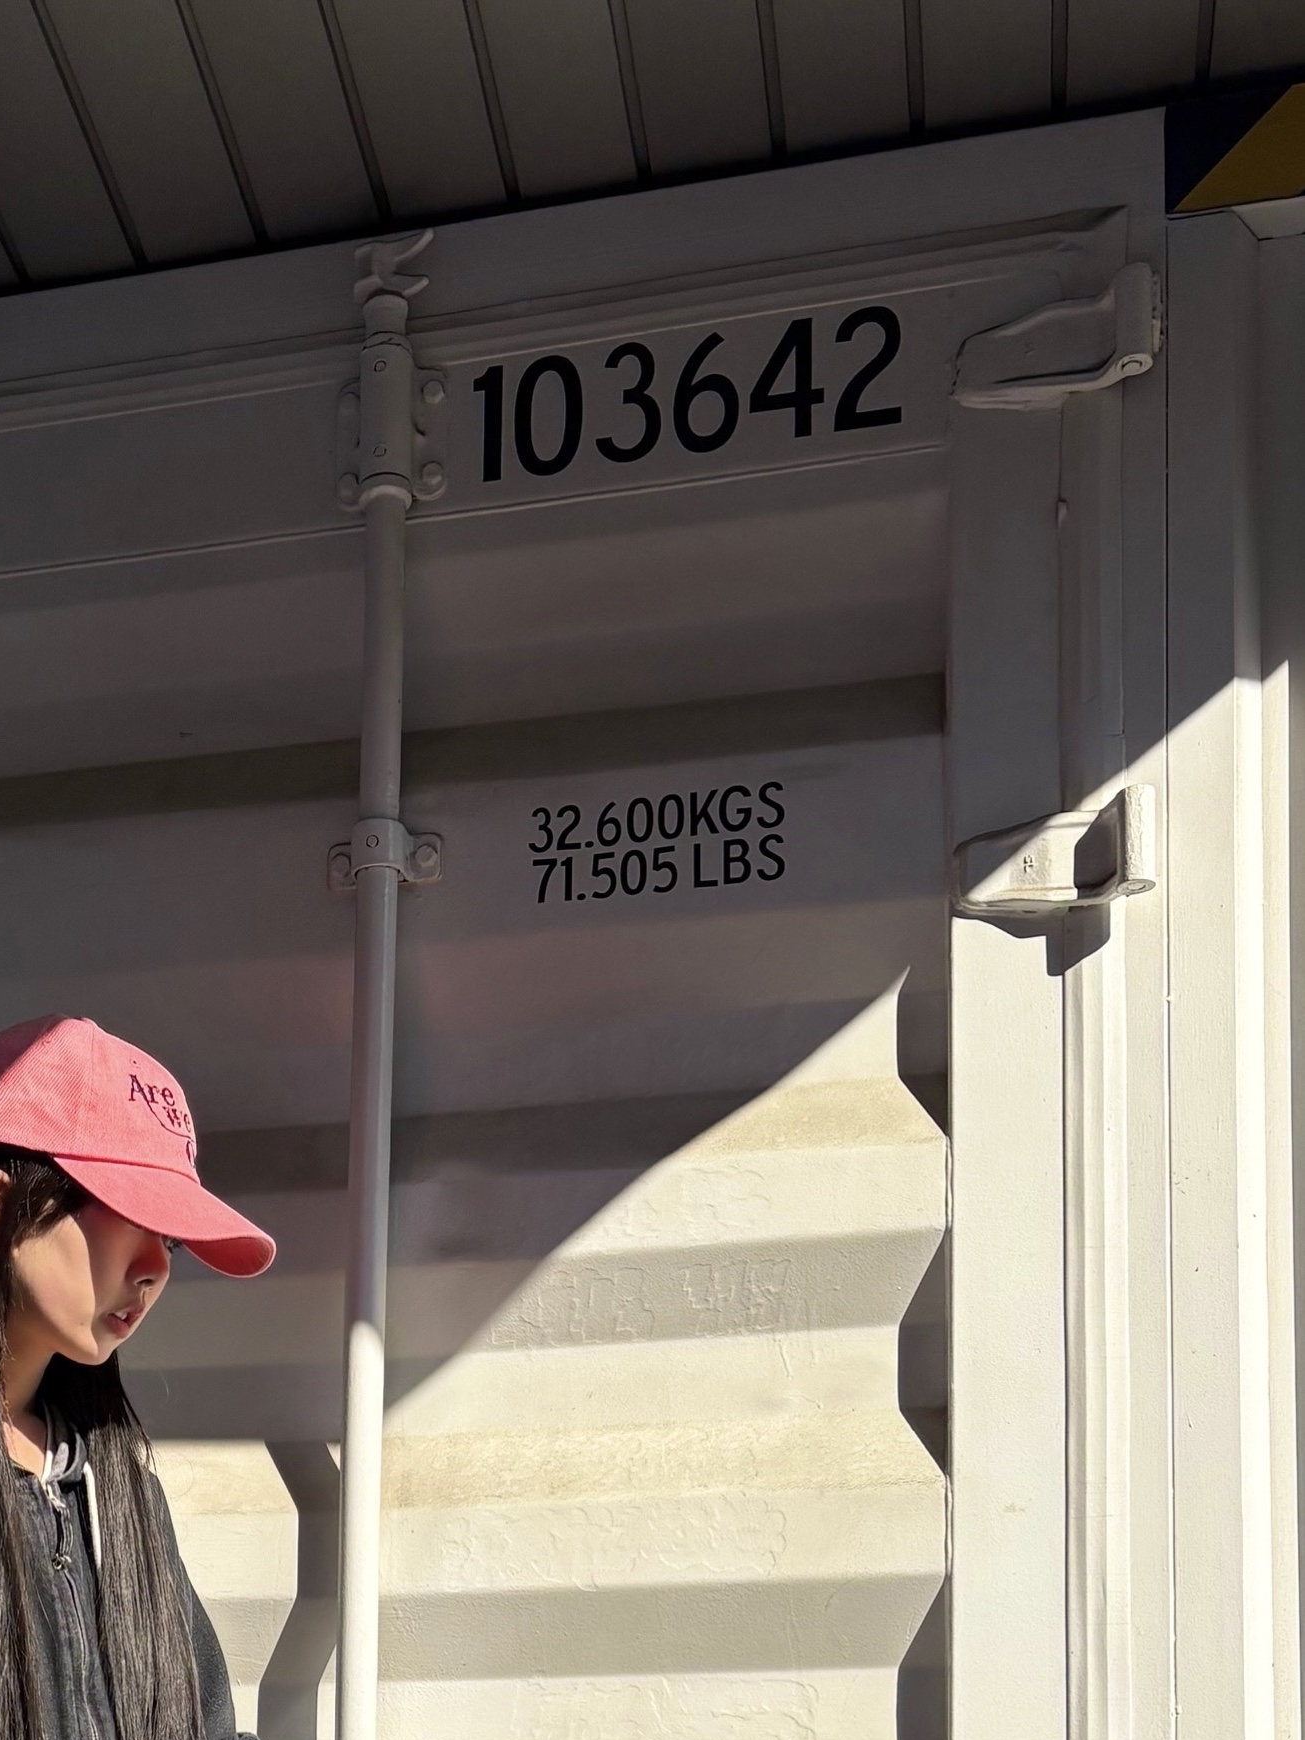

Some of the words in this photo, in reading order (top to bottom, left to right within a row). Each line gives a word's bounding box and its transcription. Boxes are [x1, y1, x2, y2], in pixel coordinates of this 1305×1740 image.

[473, 306, 902, 482] 103642
[532, 845, 678, 903] 71.505
[692, 833, 785, 888] LBS
[128, 1073, 175, 1107] Are
